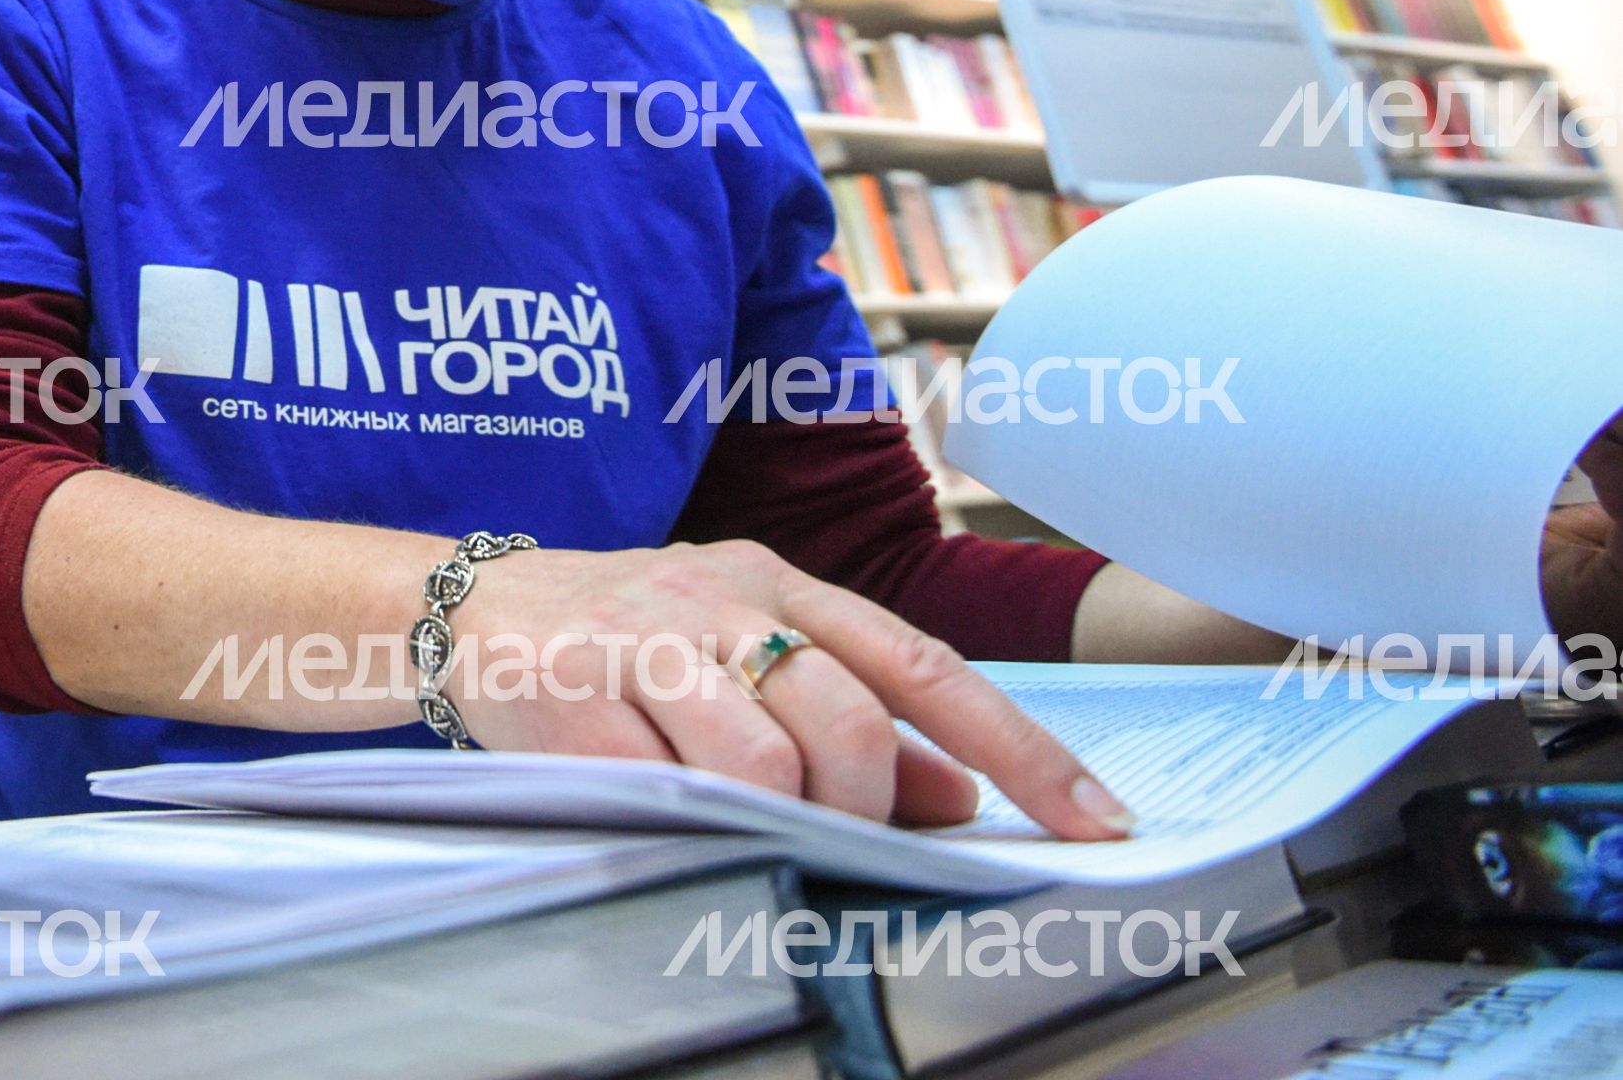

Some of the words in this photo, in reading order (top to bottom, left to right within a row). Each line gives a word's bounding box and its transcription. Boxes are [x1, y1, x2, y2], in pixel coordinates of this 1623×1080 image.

[394, 282, 618, 350] ЧИТАЙ
[398, 340, 630, 418] ГОРОД
[202, 397, 268, 421] сеть
[275, 403, 411, 432] книжных
[419, 413, 585, 439] магазинов
